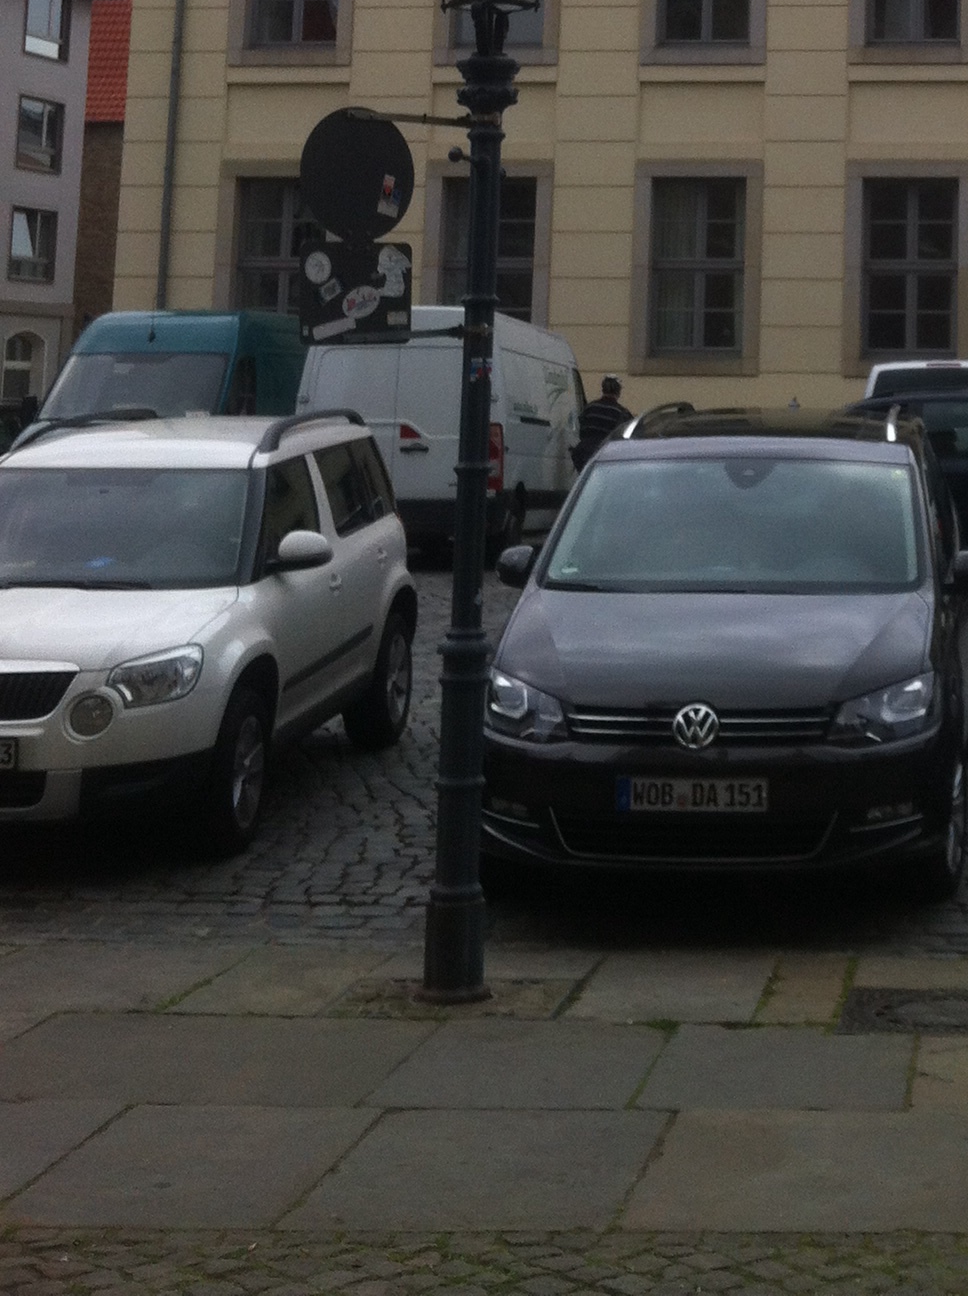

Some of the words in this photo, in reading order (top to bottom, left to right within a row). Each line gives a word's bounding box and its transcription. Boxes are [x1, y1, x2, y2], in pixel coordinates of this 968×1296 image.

[633, 782, 674, 806] WOB
[691, 783, 719, 807] DA
[725, 783, 764, 807] 151
